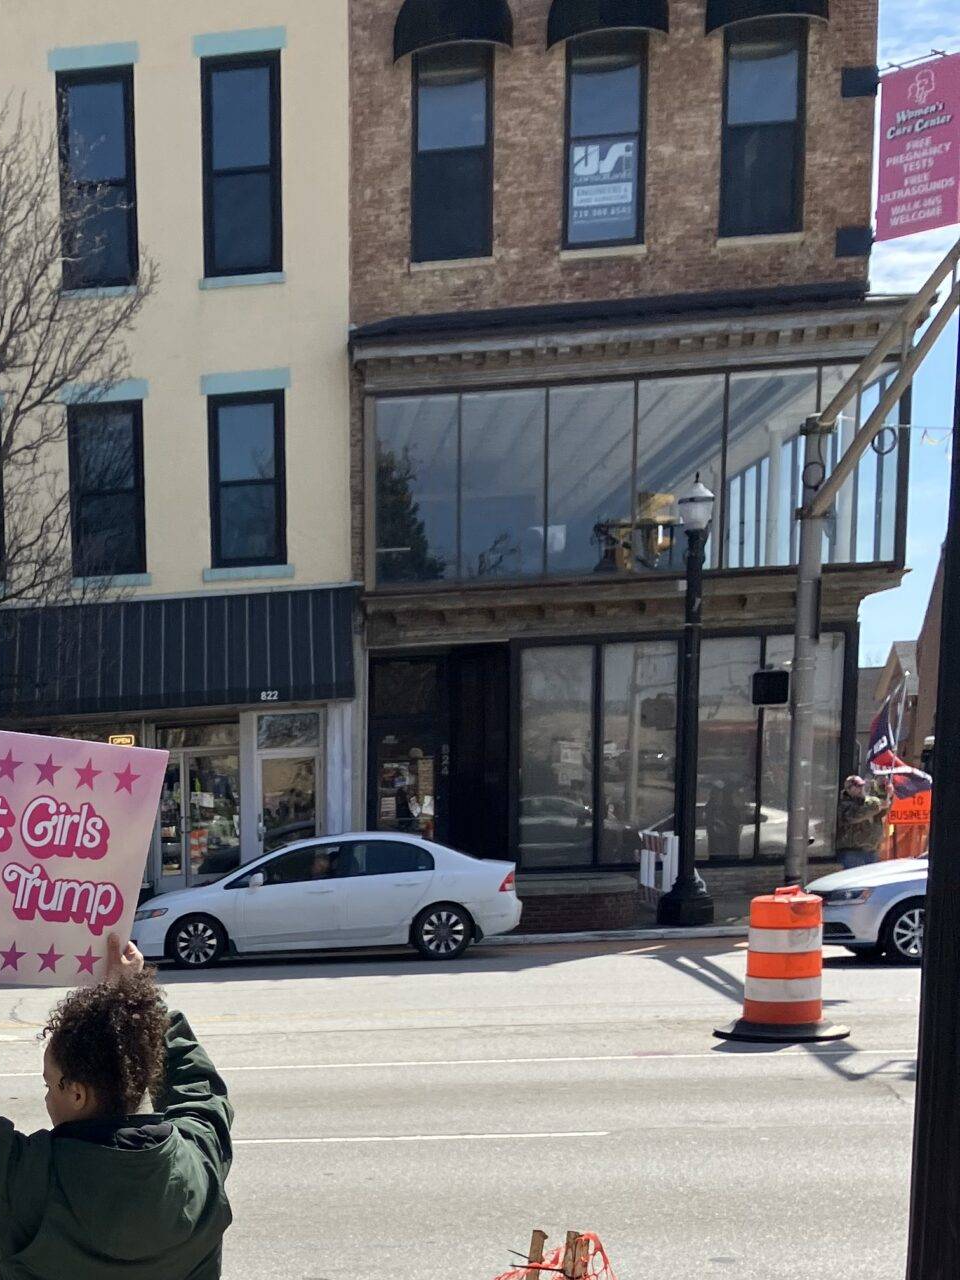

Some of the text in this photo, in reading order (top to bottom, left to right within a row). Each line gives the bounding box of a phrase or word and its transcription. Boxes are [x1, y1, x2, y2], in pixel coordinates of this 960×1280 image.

[896, 101, 944, 124] Women's
[886, 114, 953, 140] Care Center
[885, 142, 952, 168] PREGNANCY
[903, 156, 934, 173] TESTS
[880, 176, 956, 203] ULTRASOUNDS
[890, 205, 943, 226] WELCOME
[260, 690, 279, 700] 822
[112, 737, 131, 745] OPEN
[20, 795, 110, 858] Girls
[890, 809, 929, 821] BUSINES
[2, 863, 123, 934] Trump
